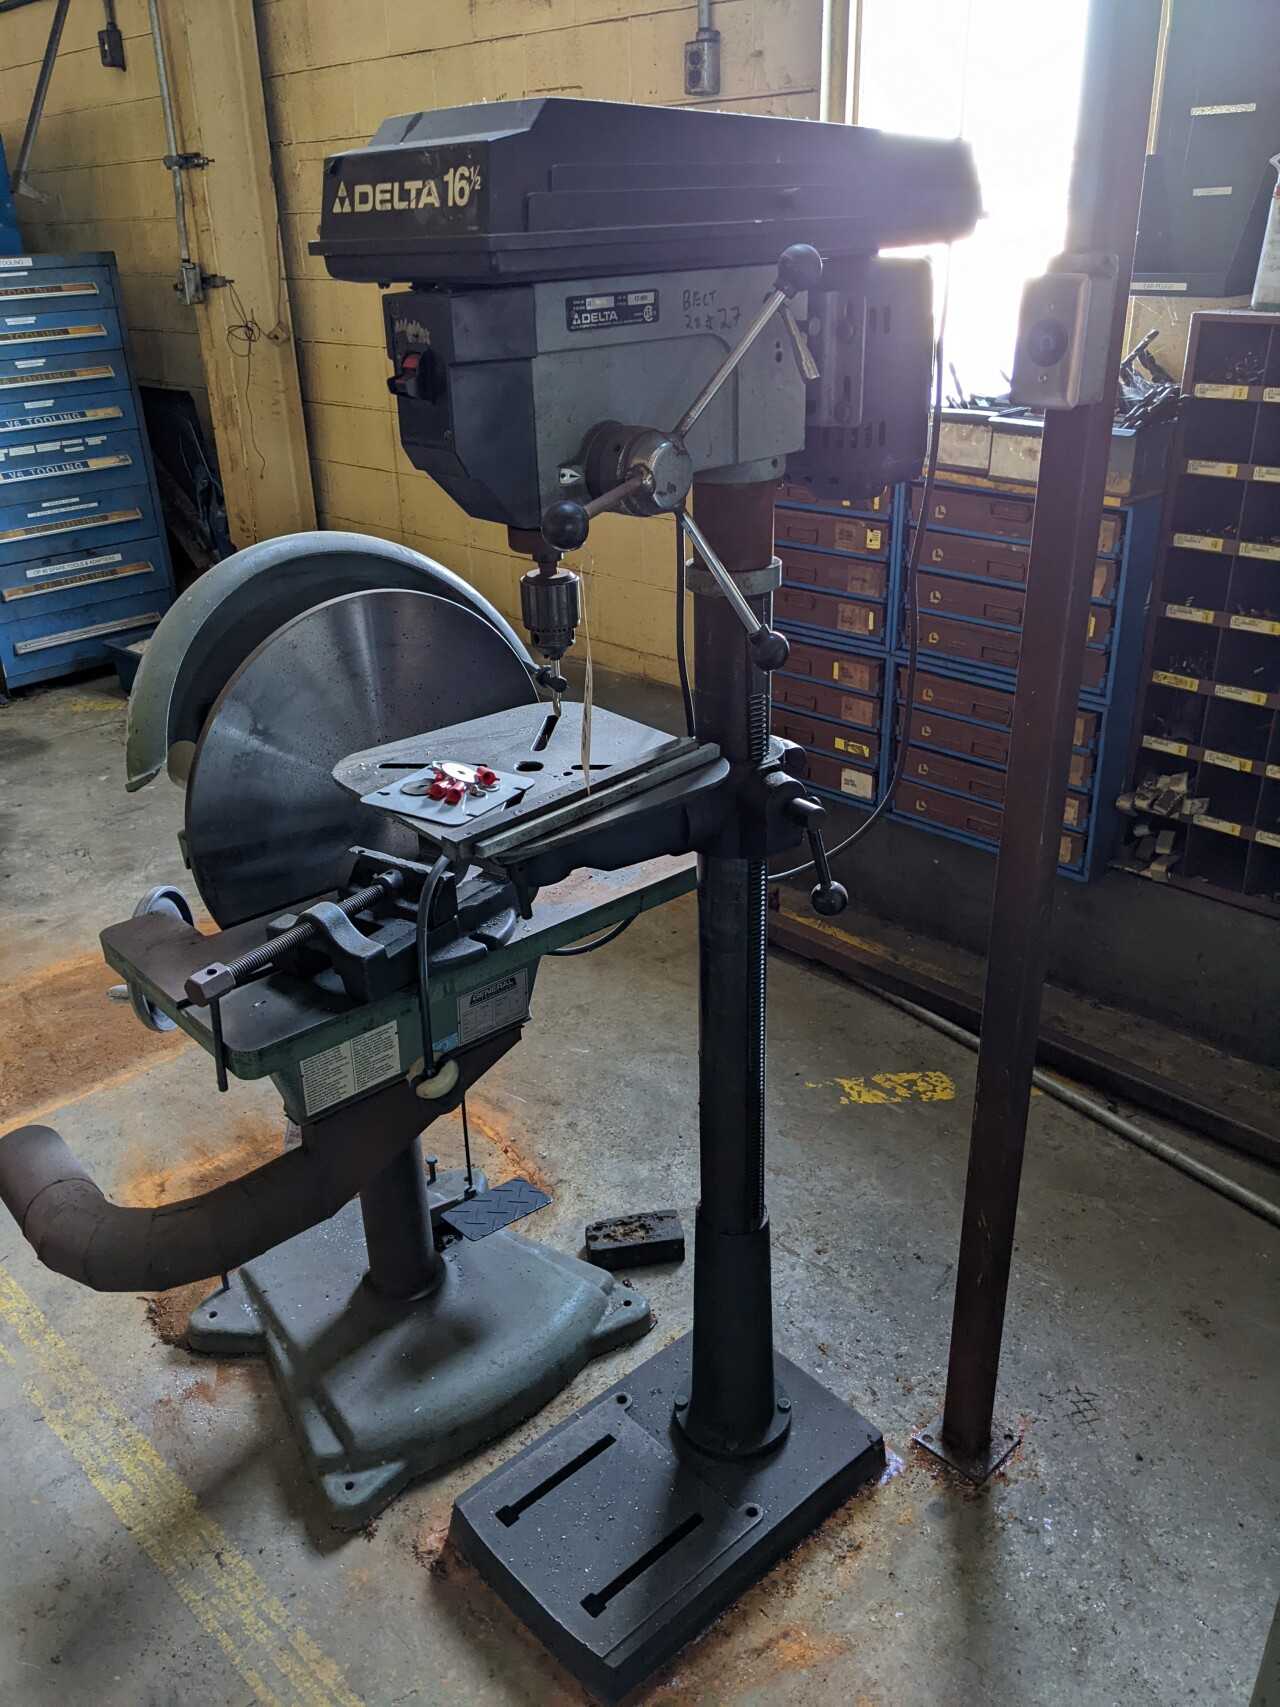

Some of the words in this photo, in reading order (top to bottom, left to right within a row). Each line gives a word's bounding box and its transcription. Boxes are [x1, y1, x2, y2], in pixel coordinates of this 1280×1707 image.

[353, 179, 441, 213] DELTA
[582, 310, 618, 324] DELTA
[27, 411, 82, 426] TOOLING
[31, 462, 84, 477] TOOLING
